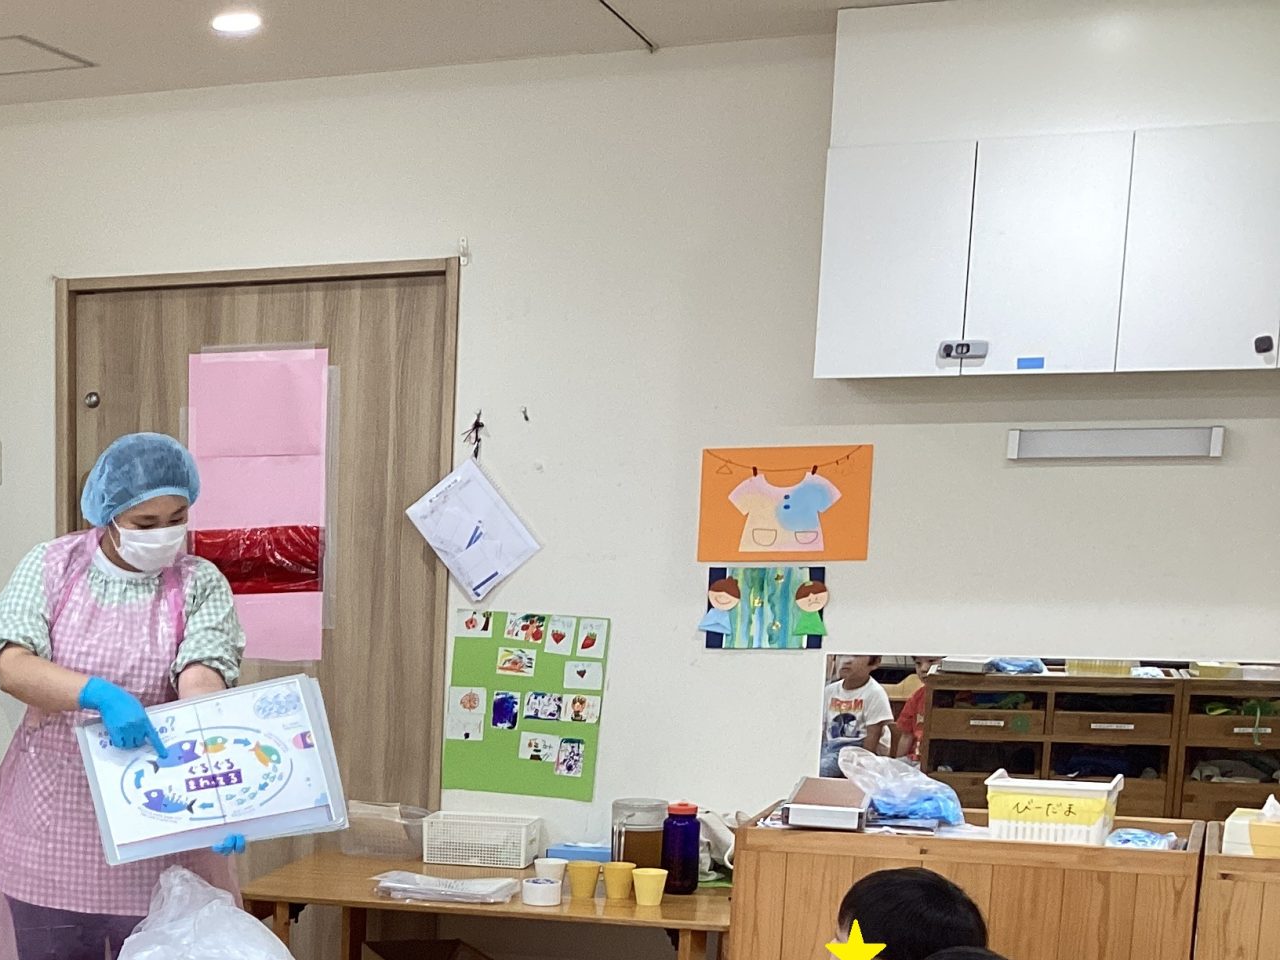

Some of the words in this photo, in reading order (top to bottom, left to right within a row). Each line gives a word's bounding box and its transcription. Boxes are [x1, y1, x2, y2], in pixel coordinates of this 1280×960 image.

[188, 758, 234, 775] ぐるぐる
[1012, 799, 1077, 817] びーだま
